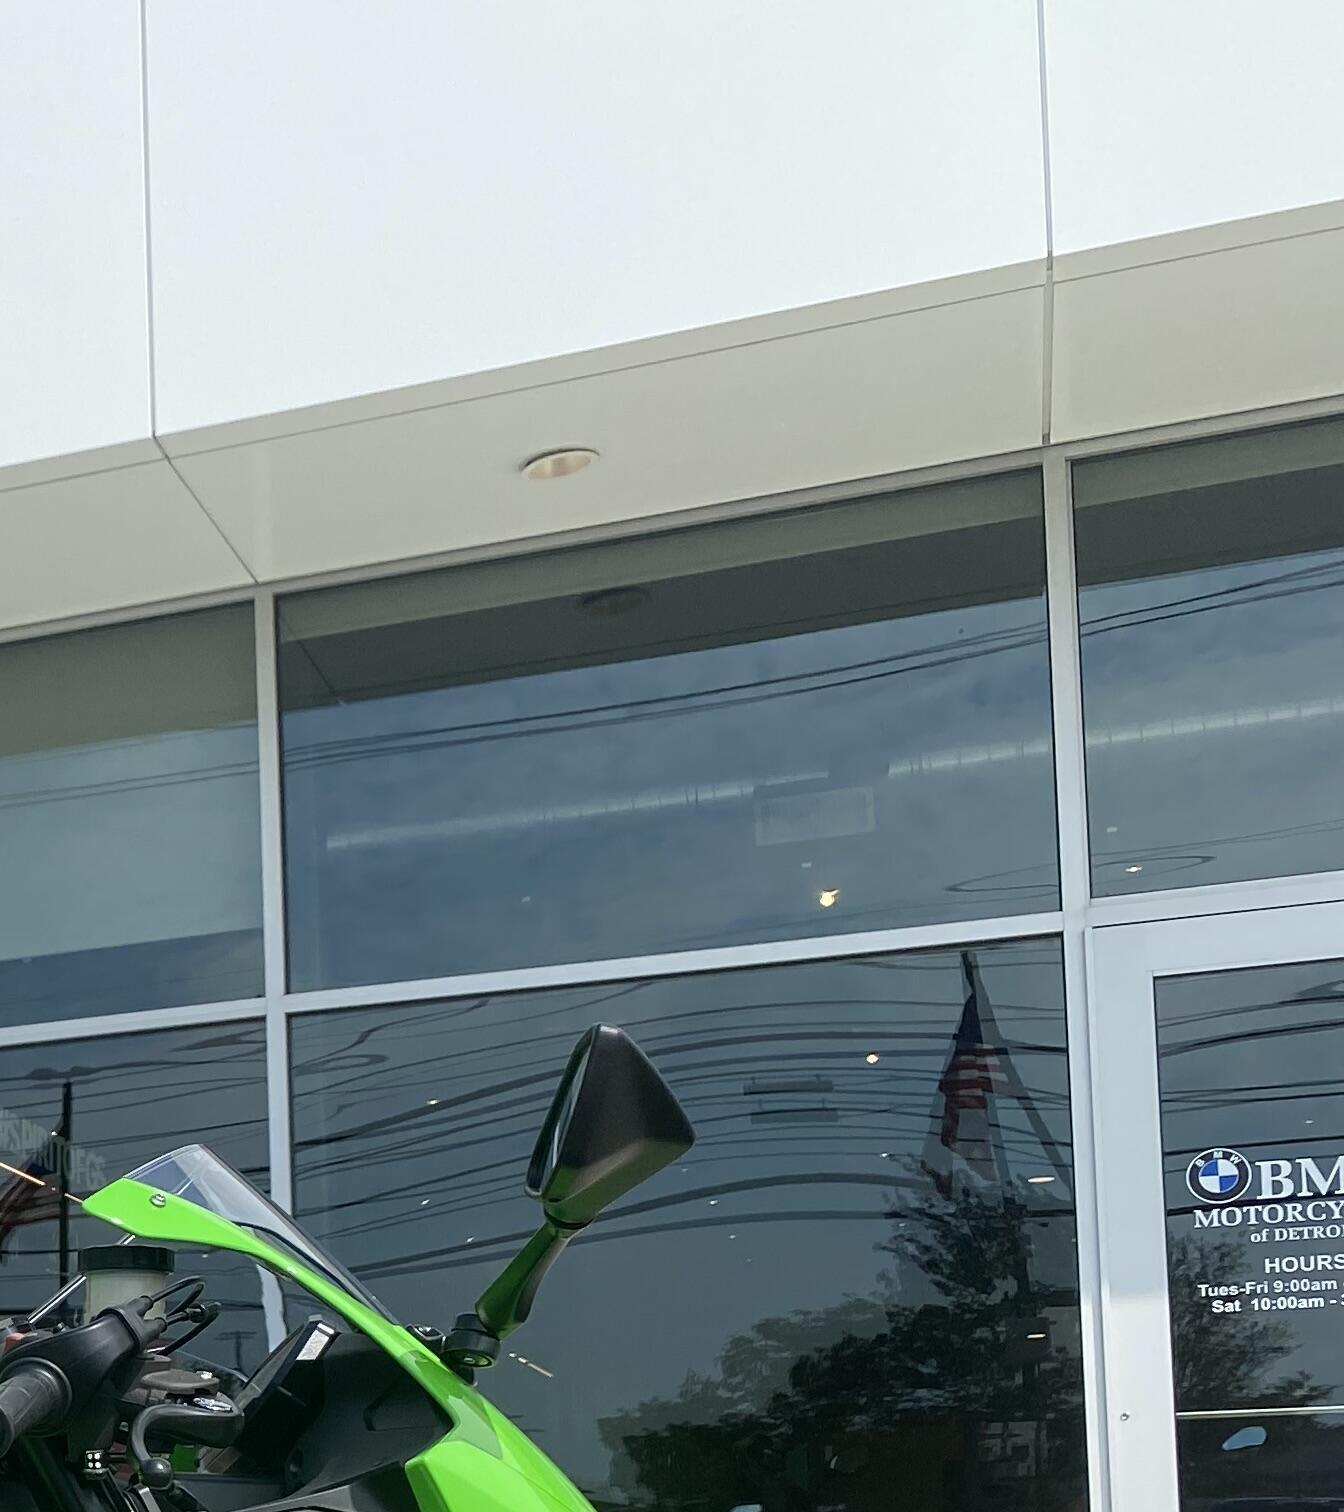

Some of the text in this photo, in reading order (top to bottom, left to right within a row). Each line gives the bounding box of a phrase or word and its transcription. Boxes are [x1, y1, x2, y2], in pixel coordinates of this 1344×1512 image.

[1250, 1228, 1270, 1243] of
[1264, 1253, 1344, 1274] HOURS
[1197, 1278, 1338, 1298] Tues-Fri 9:00am
[1211, 1299, 1242, 1314] Sat
[1250, 1295, 1325, 1311] 10:00am
